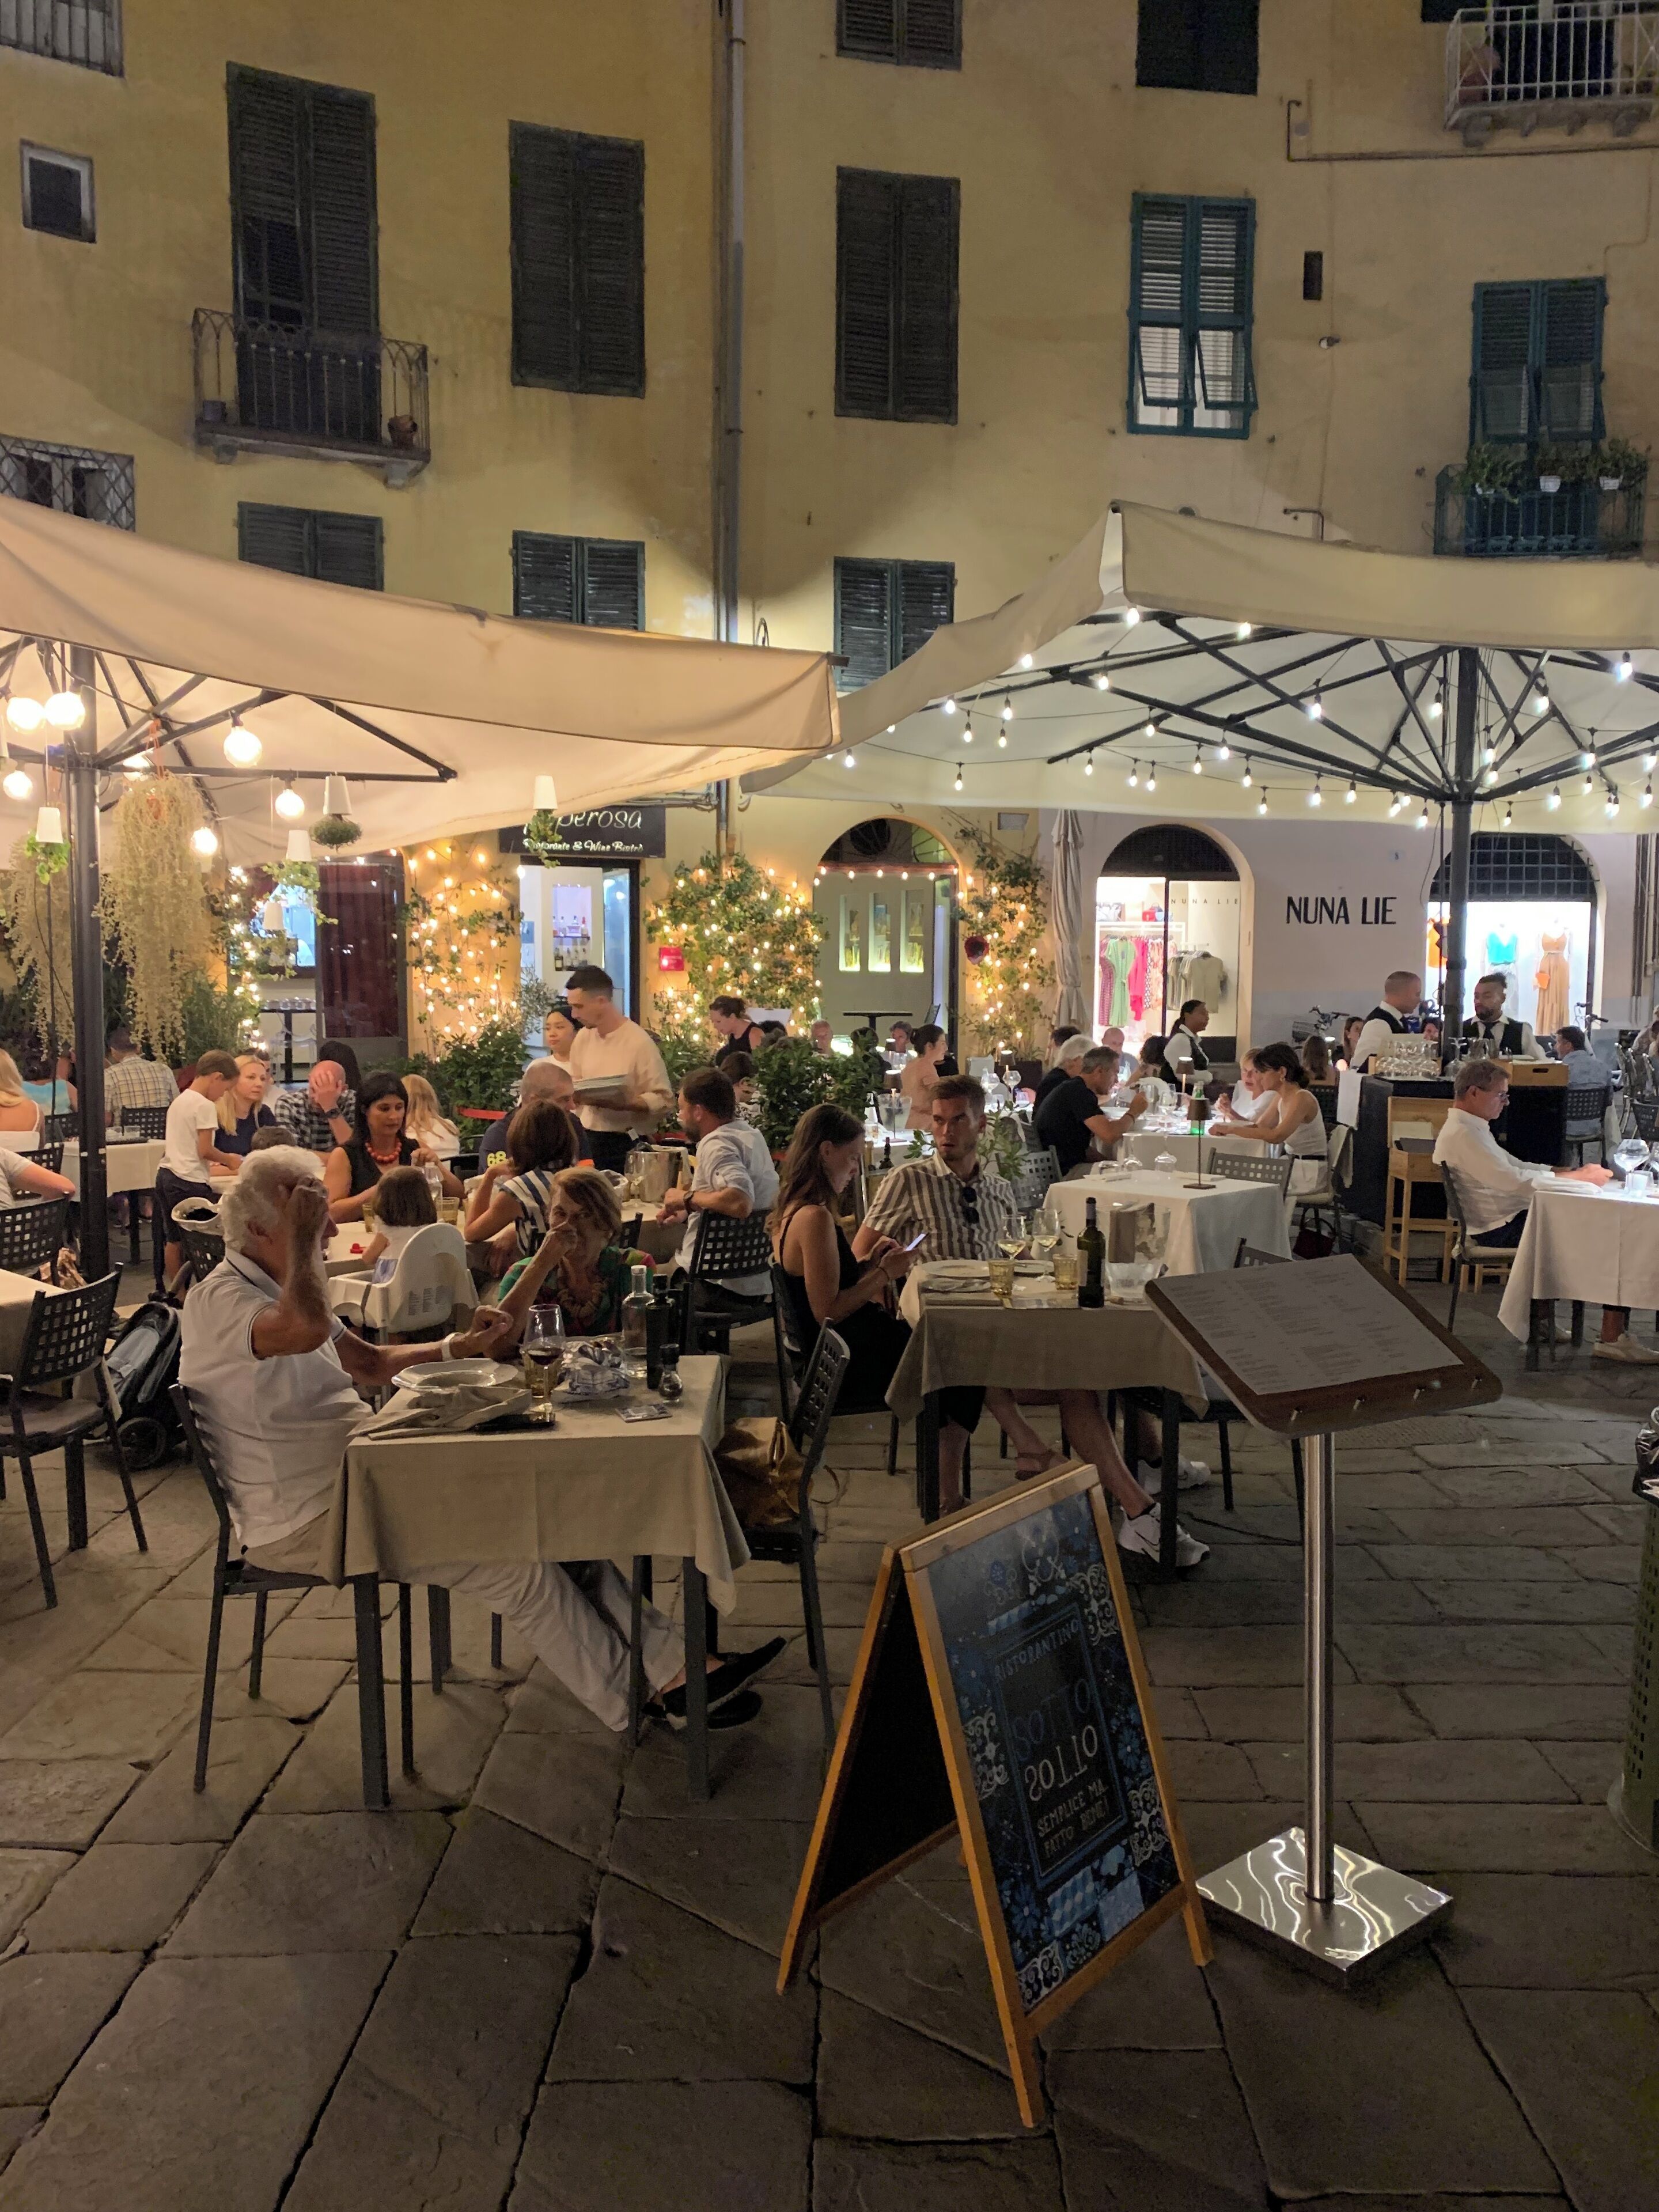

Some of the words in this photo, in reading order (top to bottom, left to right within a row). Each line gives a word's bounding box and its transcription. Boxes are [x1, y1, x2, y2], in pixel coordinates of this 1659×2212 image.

[573, 841, 582, 851] &
[585, 840, 611, 851] Wine
[1286, 896, 1350, 924] NUNA
[1361, 897, 1397, 925] LIE
[996, 1619, 1080, 1681] RISTORANTINO
[1037, 1791, 1086, 1838] SEMPLICE
[1044, 1827, 1074, 1859] FATTO
